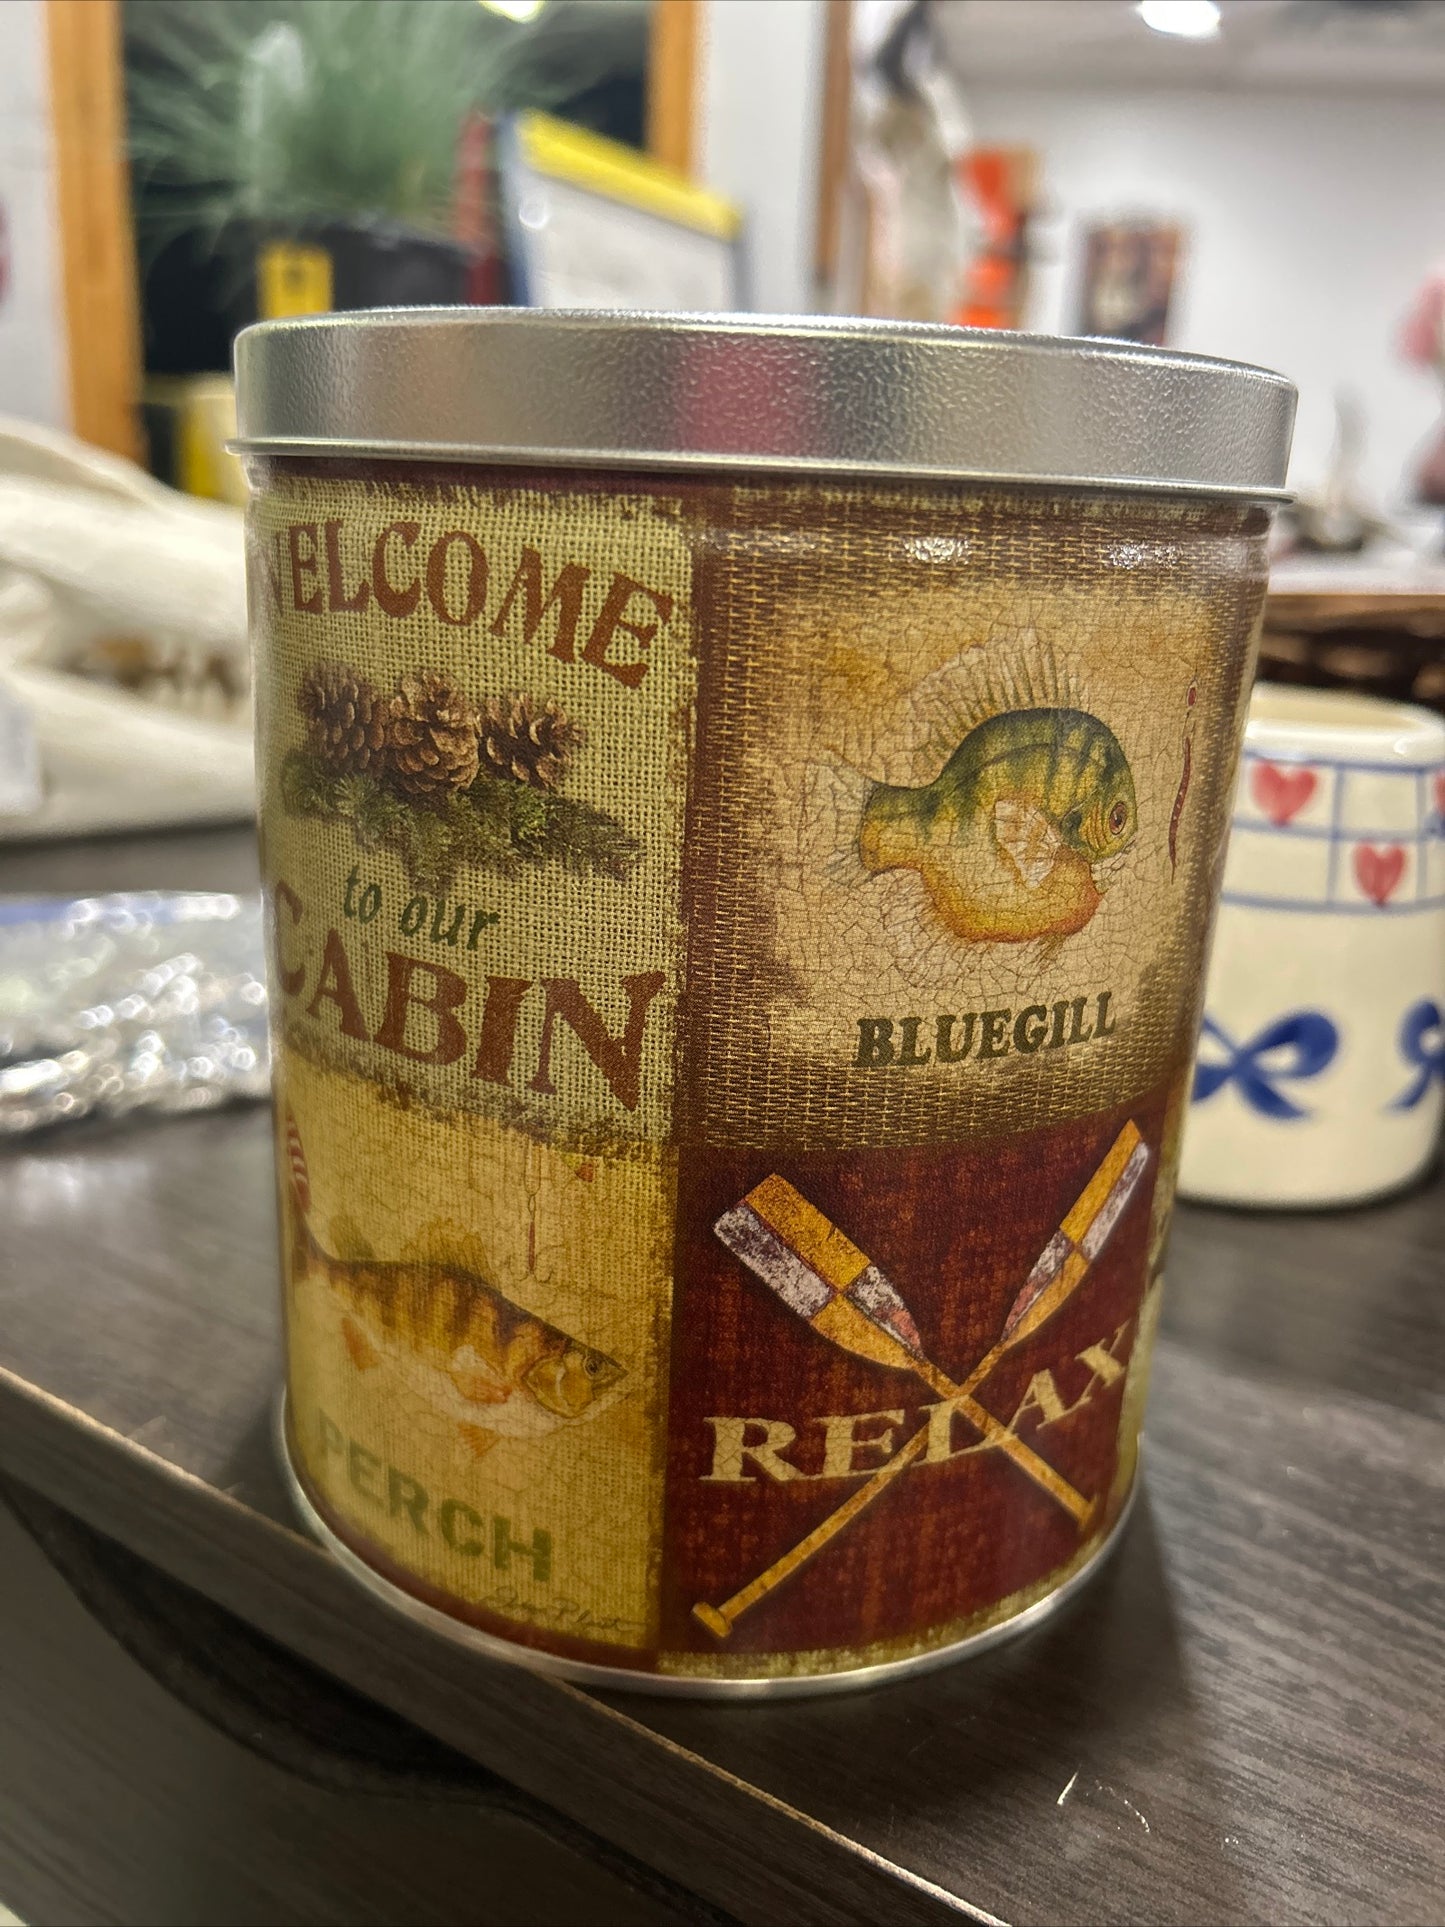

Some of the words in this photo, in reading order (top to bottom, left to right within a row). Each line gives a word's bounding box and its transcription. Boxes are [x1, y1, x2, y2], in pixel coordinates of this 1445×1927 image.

[342, 864, 383, 924] to
[400, 893, 499, 951] our
[274, 880, 667, 1112] CABIN
[851, 990, 1116, 1068] BLUEGILL
[699, 1319, 1130, 1482] RELAX
[318, 1407, 553, 1582] PERCH
